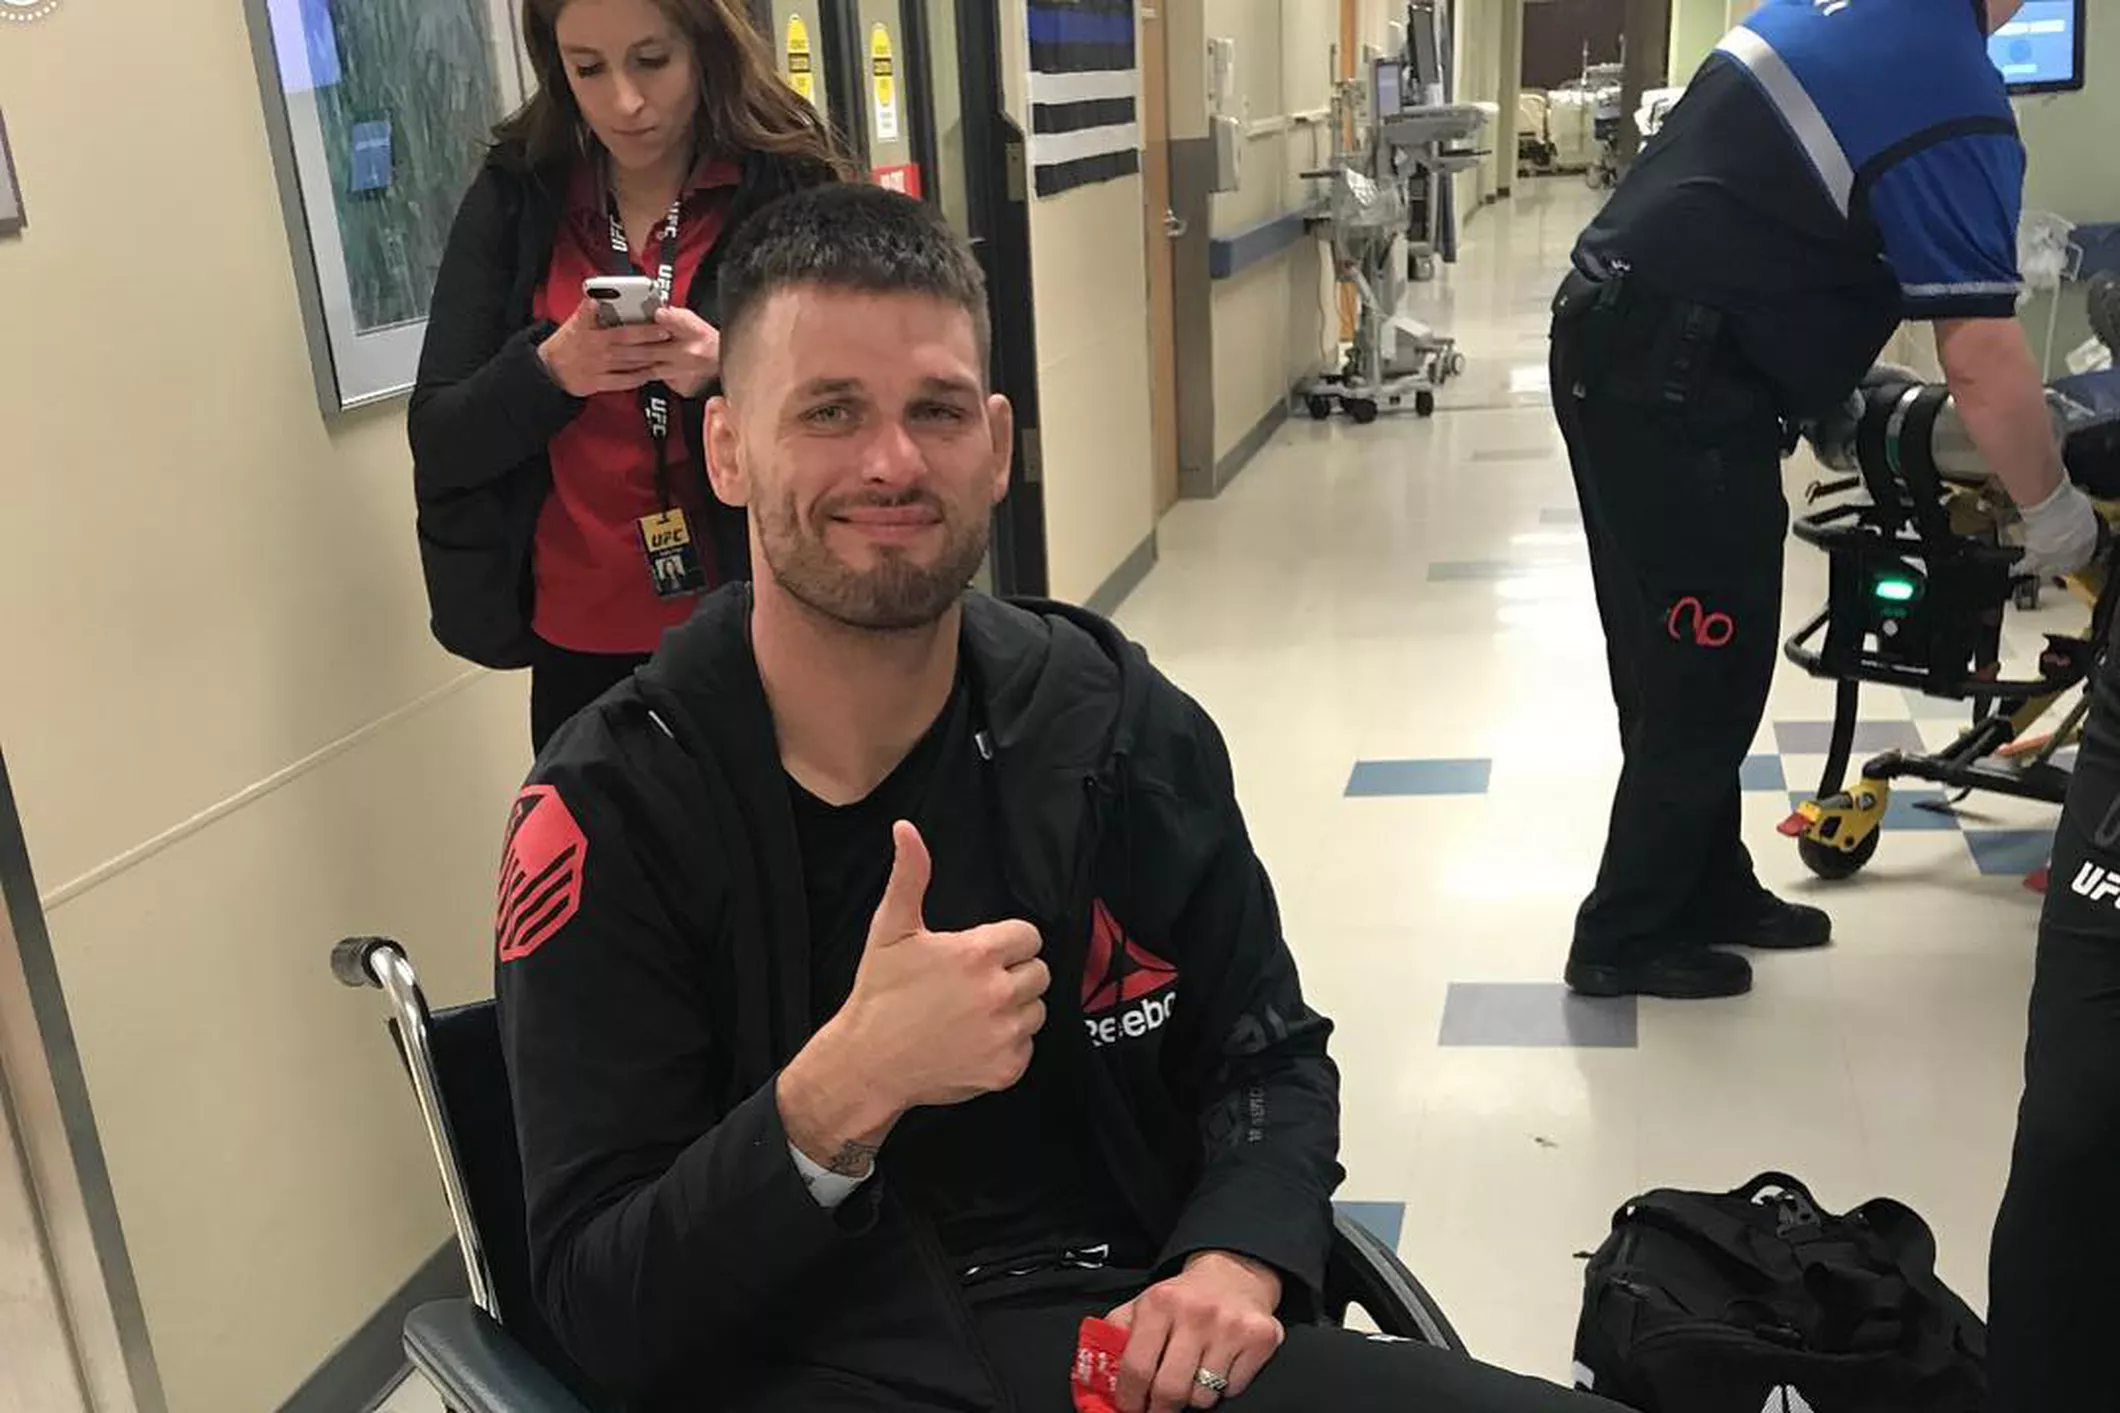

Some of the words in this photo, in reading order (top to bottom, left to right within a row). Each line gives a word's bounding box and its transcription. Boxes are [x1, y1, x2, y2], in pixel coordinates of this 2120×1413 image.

[651, 397, 667, 437] UFC
[652, 528, 684, 547] UFC
[2071, 860, 2120, 909] UF
